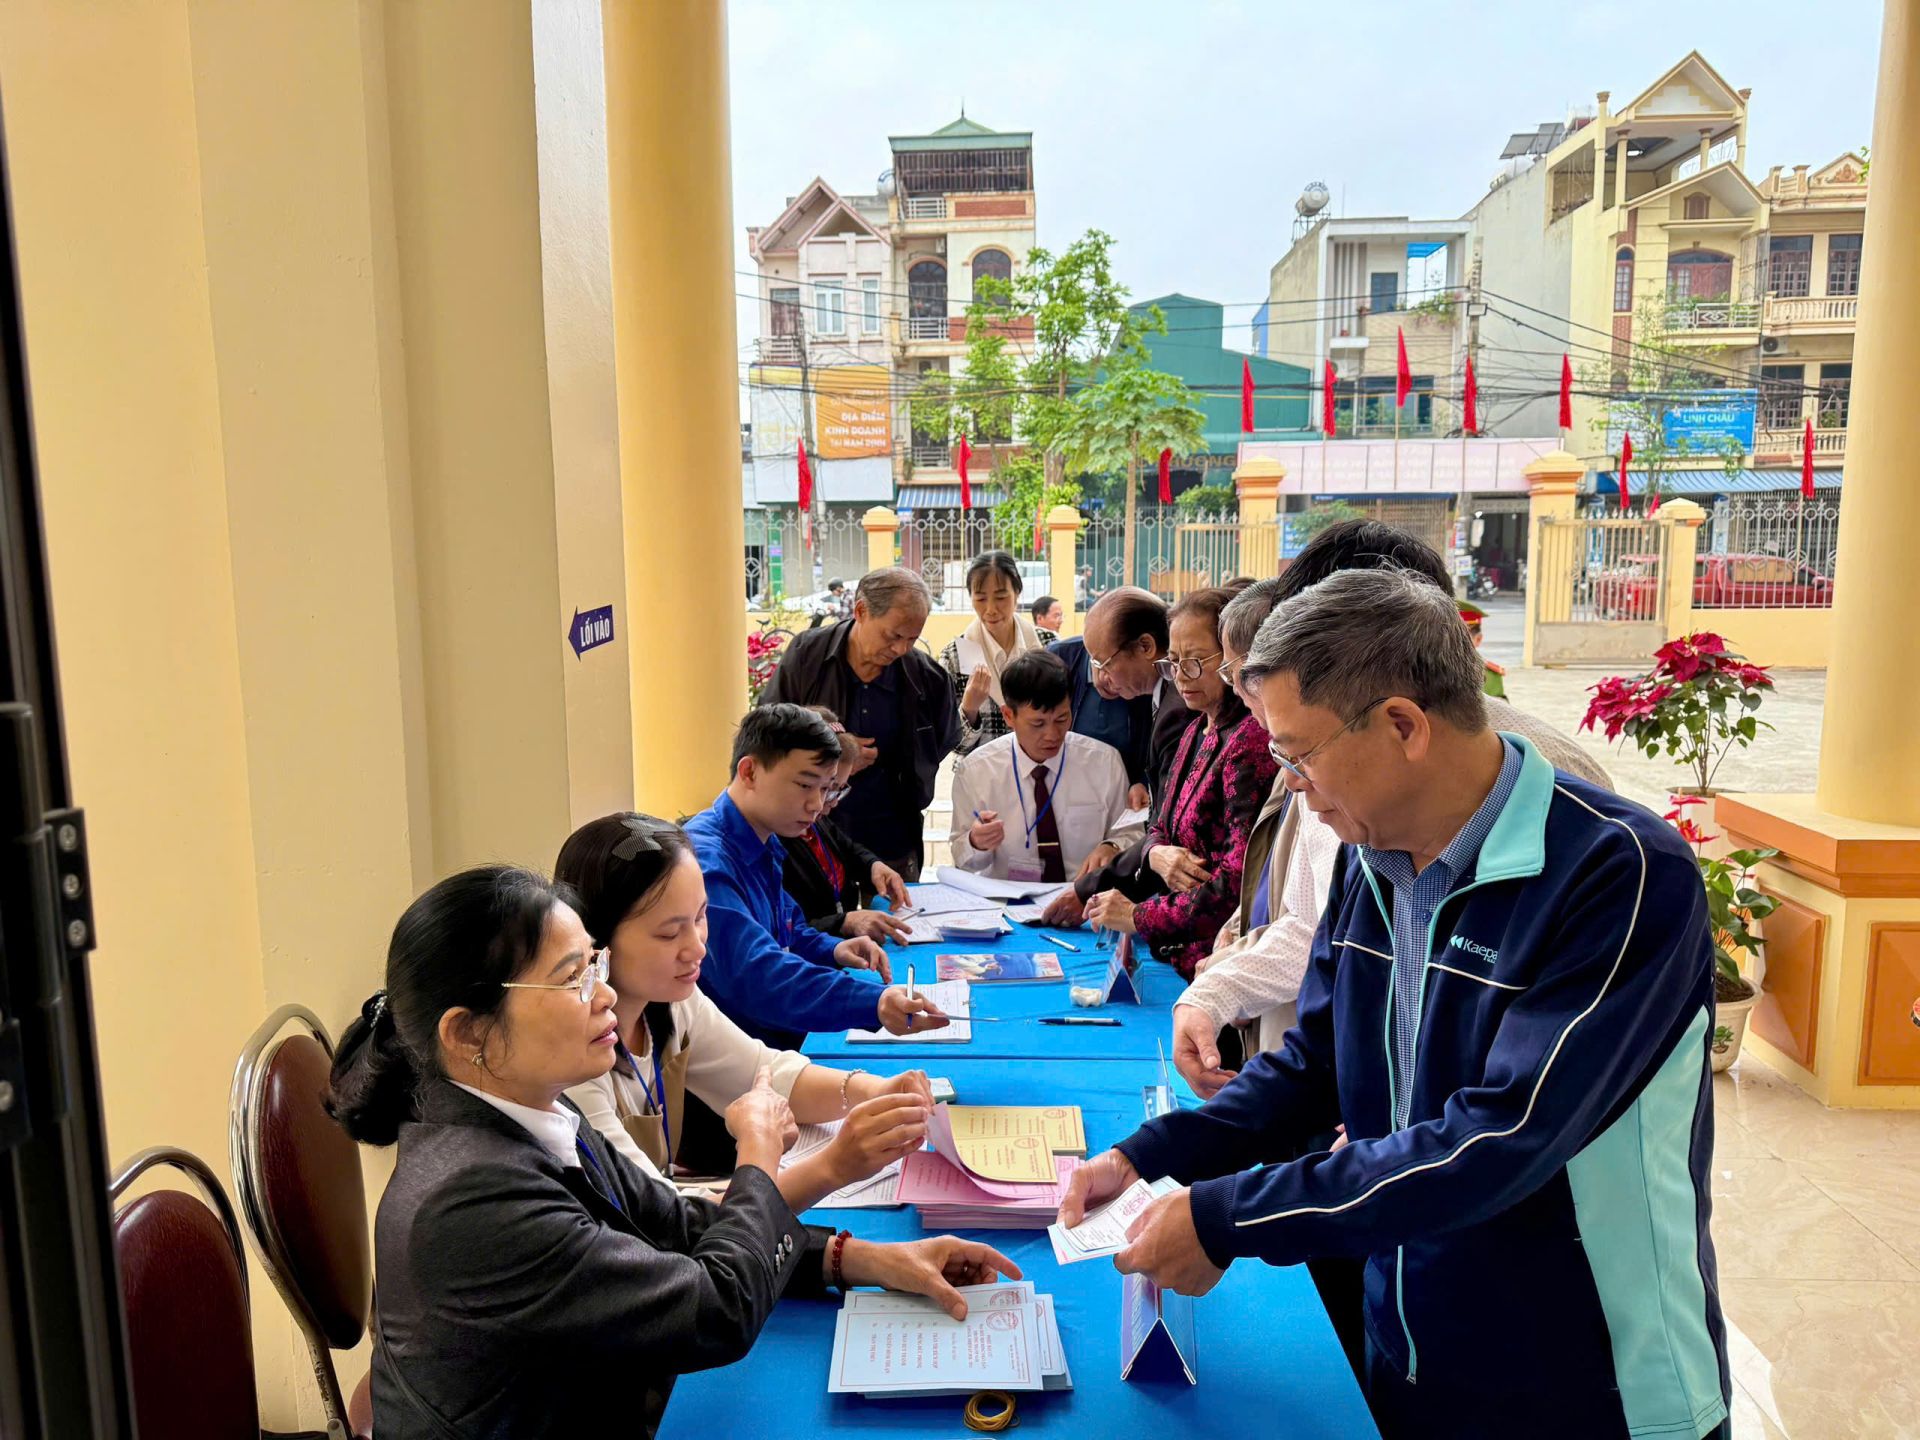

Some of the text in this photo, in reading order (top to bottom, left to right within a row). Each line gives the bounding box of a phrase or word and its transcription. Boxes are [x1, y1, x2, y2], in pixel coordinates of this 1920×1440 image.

[1683, 414, 1706, 424] LINH
[825, 425, 886, 435] KINH DOANH
[580, 615, 610, 647] LỐI VÀO
[1463, 938, 1499, 961] Kaepa
